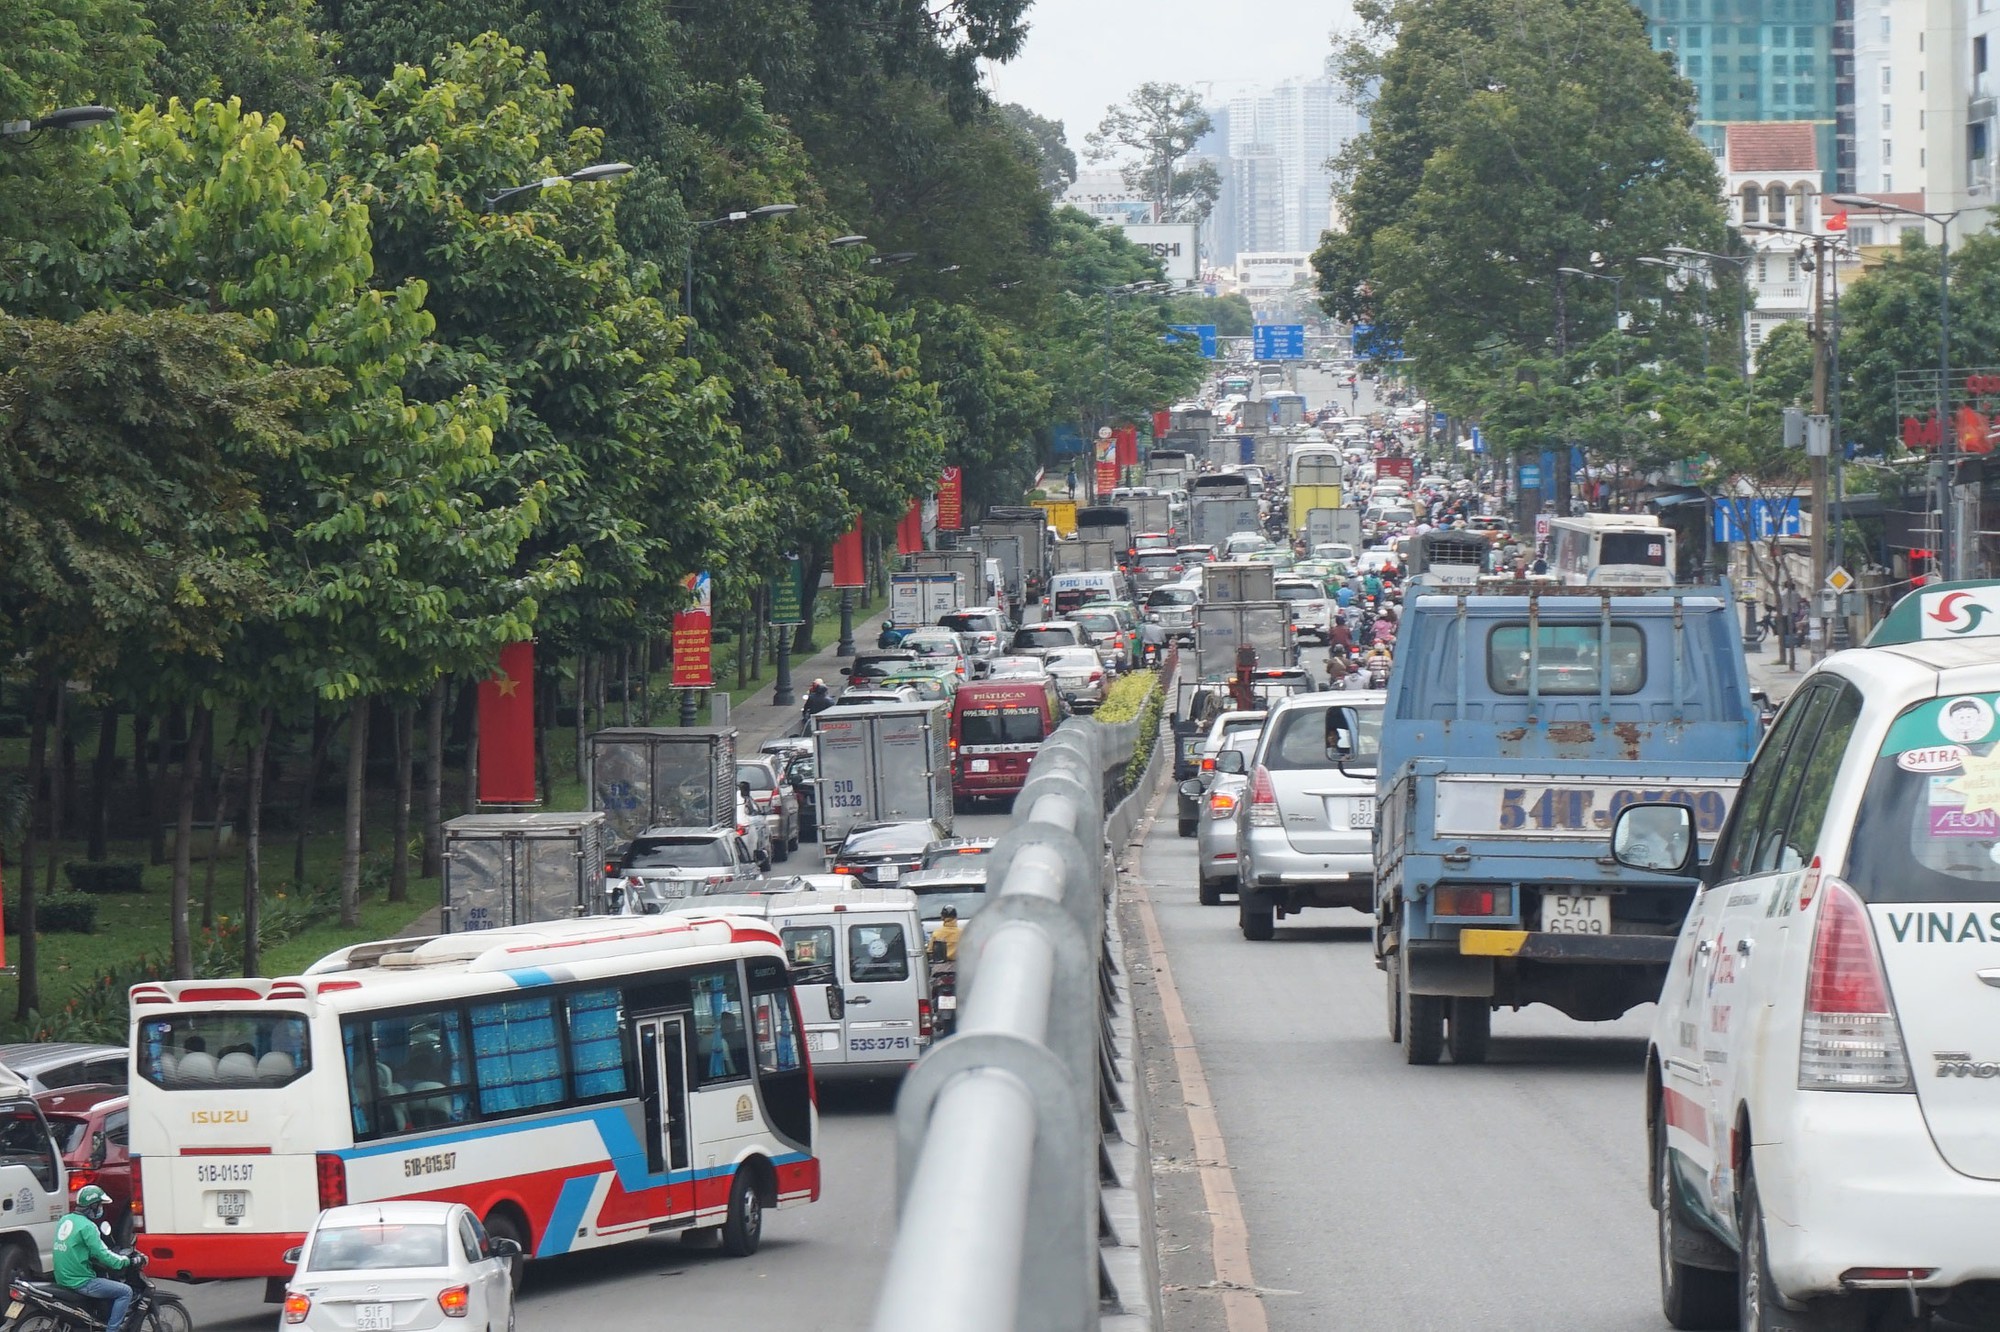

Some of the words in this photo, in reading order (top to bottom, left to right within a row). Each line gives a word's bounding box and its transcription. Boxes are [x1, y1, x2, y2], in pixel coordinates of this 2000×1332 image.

[1908, 749, 1960, 765] SATRA
[834, 780, 853, 793] 51D
[829, 794, 862, 808] 133.28
[1557, 896, 1593, 917] 54T
[1550, 918, 1602, 934] 6599
[191, 1110, 249, 1124] ISUZU
[404, 1151, 457, 1178] 51B-015.97
[198, 1164, 253, 1182] 51B-015.97
[223, 1193, 239, 1205] 51B
[365, 1305, 384, 1319] 51F
